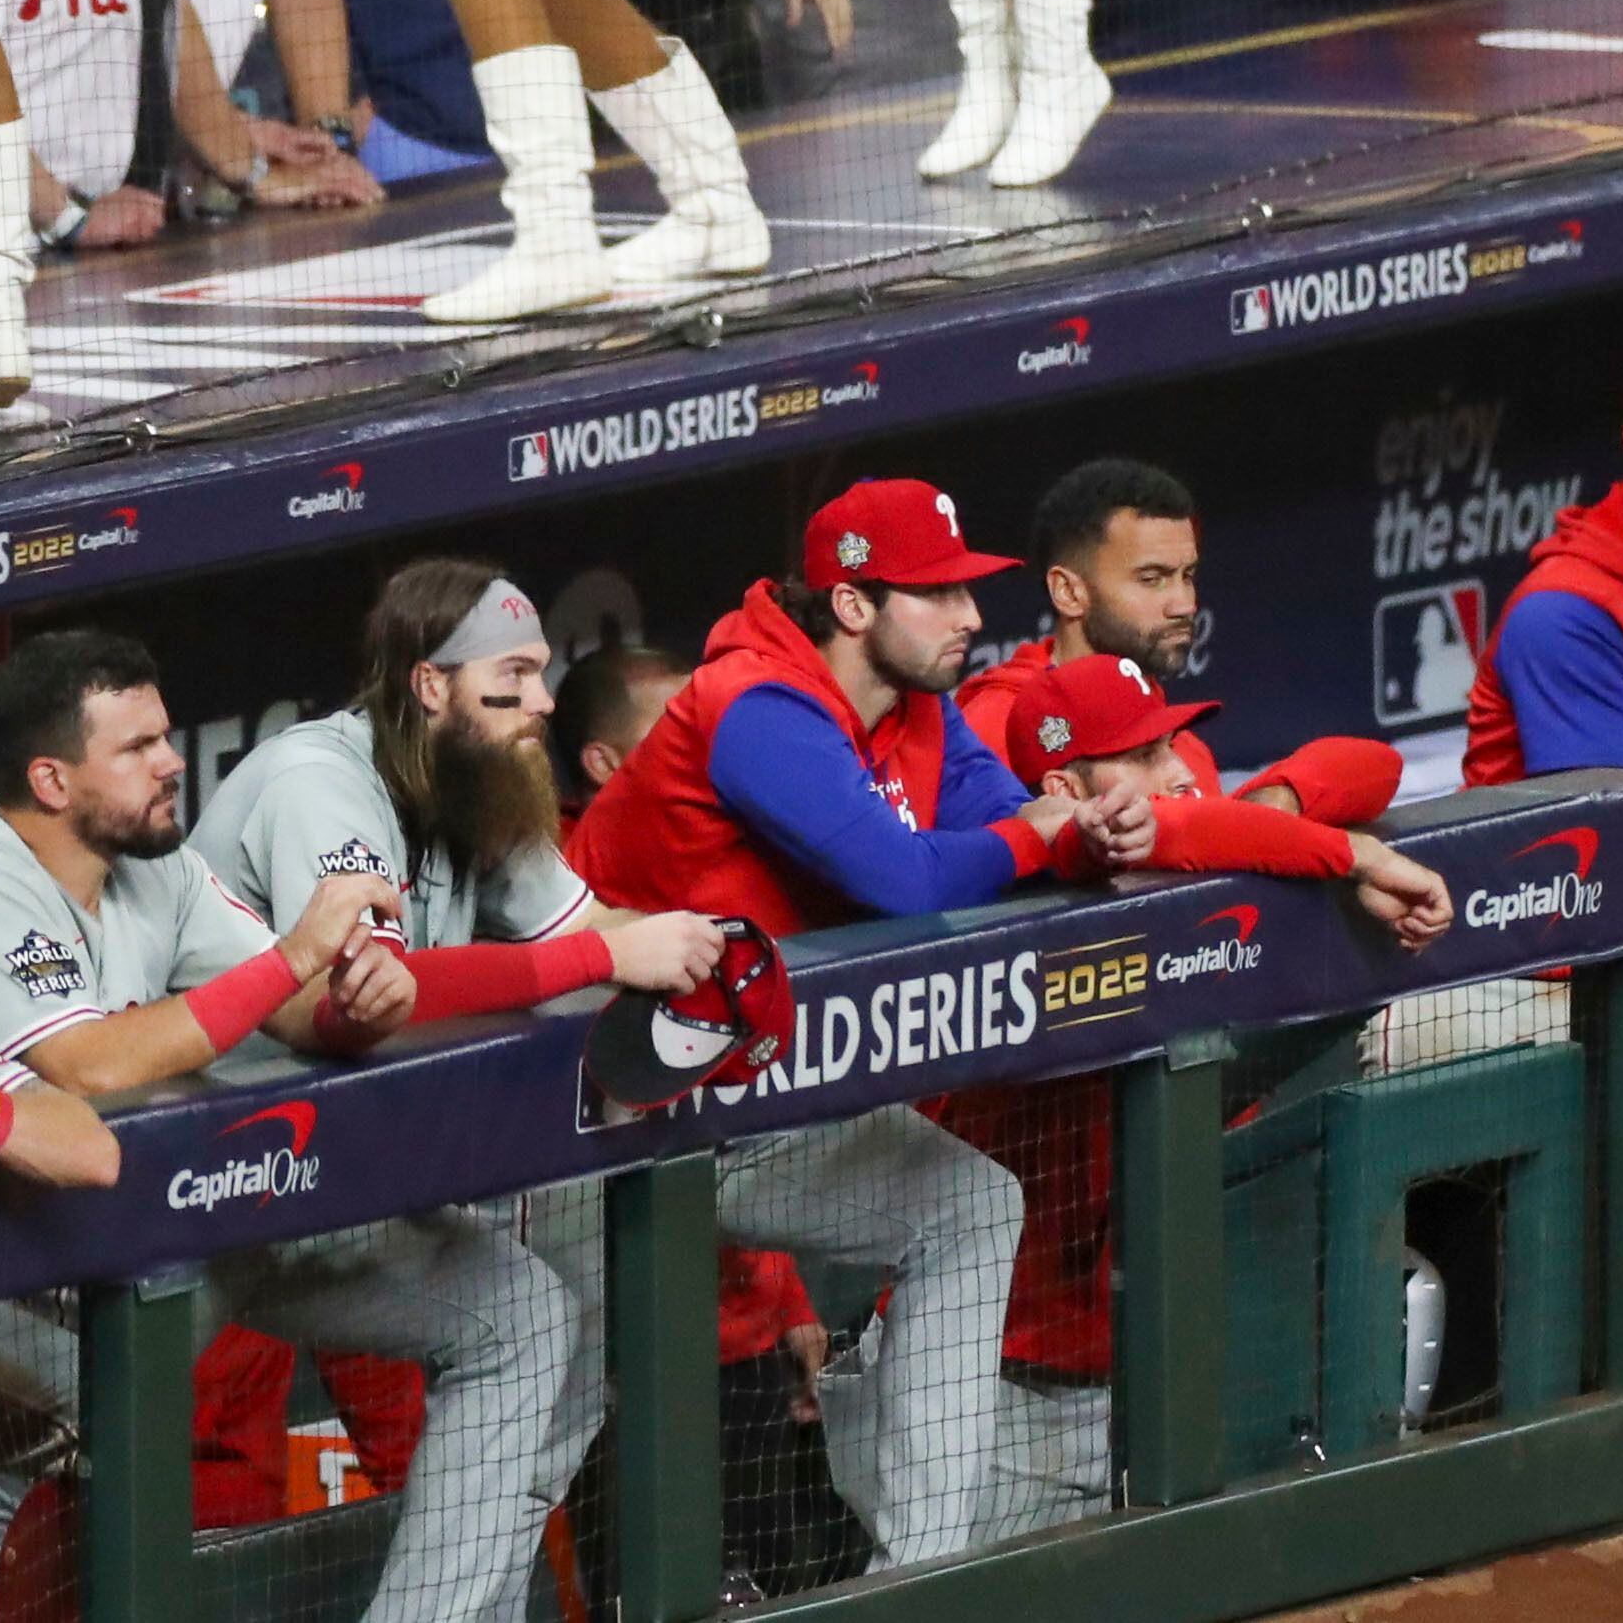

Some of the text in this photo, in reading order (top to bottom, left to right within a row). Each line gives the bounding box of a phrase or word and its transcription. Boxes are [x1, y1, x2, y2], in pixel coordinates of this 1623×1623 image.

[1269, 266, 1375, 328] WORLD
[1378, 242, 1469, 306] SERIES
[548, 406, 662, 475] WORLD
[664, 383, 759, 452] SERIES
[759, 385, 820, 420] 2022
[13, 533, 76, 567] 2022
[1374, 488, 1454, 577] the
[320, 850, 391, 878] WORLD
[7, 943, 75, 969] WORLD
[26, 972, 86, 998] SERIES
[868, 950, 1040, 1074] SERIES
[1044, 953, 1149, 1013] 2022
